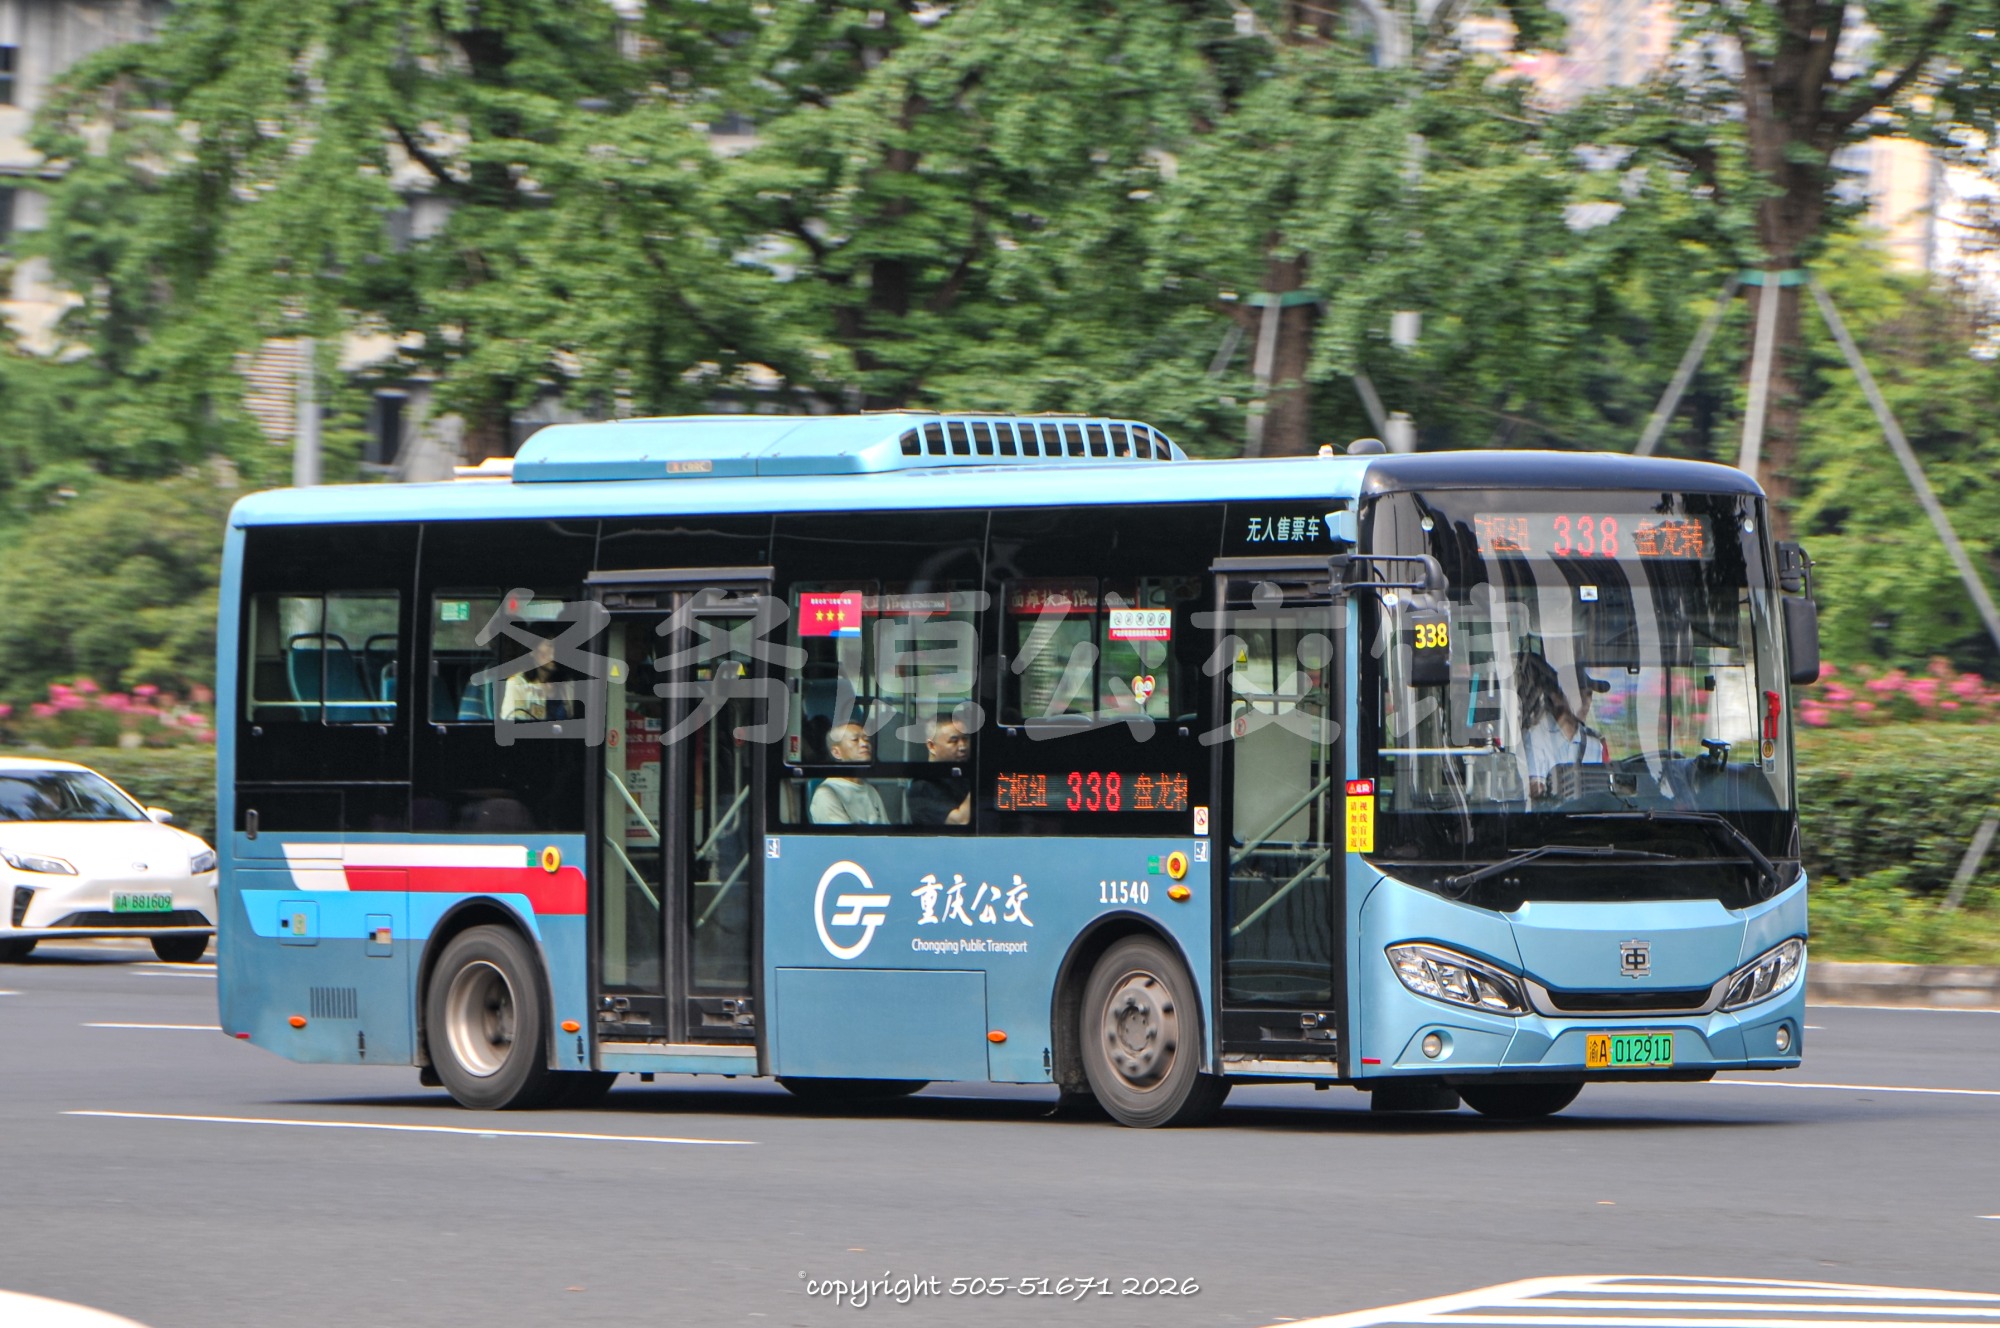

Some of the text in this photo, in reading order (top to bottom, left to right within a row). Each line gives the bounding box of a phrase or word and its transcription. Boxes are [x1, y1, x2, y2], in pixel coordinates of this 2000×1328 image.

[1246, 515, 1320, 542] 无人售票车
[1553, 515, 1618, 557] 338
[1415, 622, 1448, 649] 338
[1067, 771, 1121, 811] 338
[911, 873, 1034, 927] 重庆公交
[1099, 881, 1149, 904] 11540
[911, 938, 1028, 955] Chongqing Public Transport
[1615, 1038, 1671, 1063] 01291D
